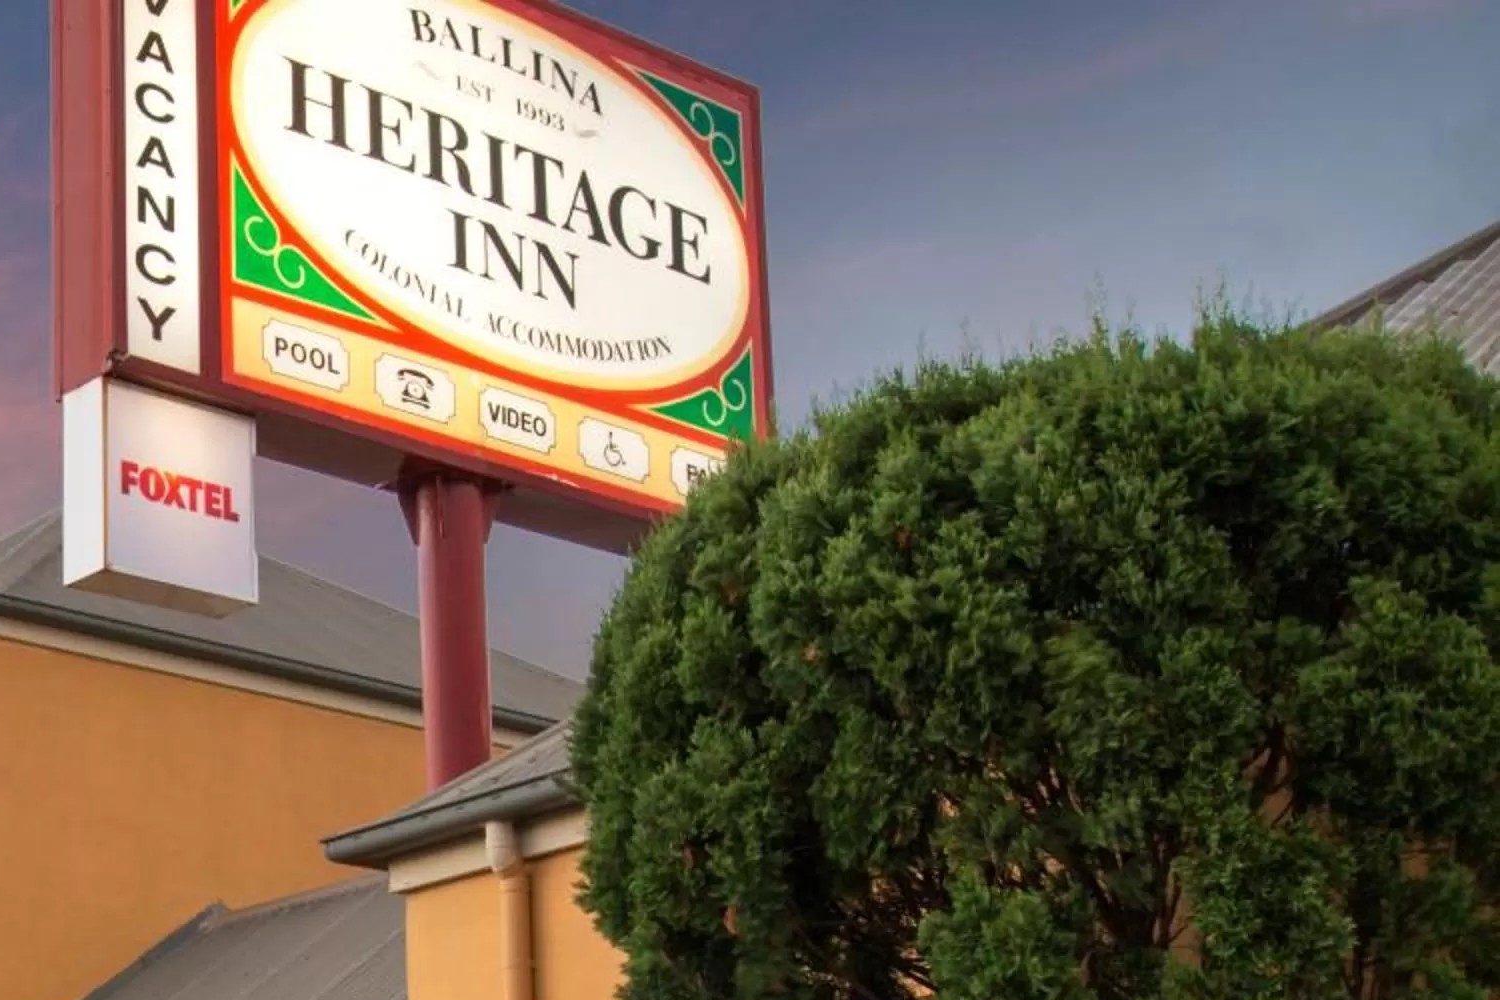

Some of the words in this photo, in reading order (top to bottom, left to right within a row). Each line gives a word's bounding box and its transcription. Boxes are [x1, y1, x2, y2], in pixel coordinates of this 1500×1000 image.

[408, 7, 602, 116] BALLINA
[456, 74, 495, 103] EST
[515, 97, 565, 132] 1993
[283, 55, 712, 285] HERITAGE
[344, 228, 471, 323] COLONIAL
[483, 311, 673, 363] ACCOMMODATION
[447, 207, 580, 310] INN
[273, 336, 341, 376] POOL
[487, 400, 548, 438] VIDEO
[120, 459, 241, 523] FOXTEL
